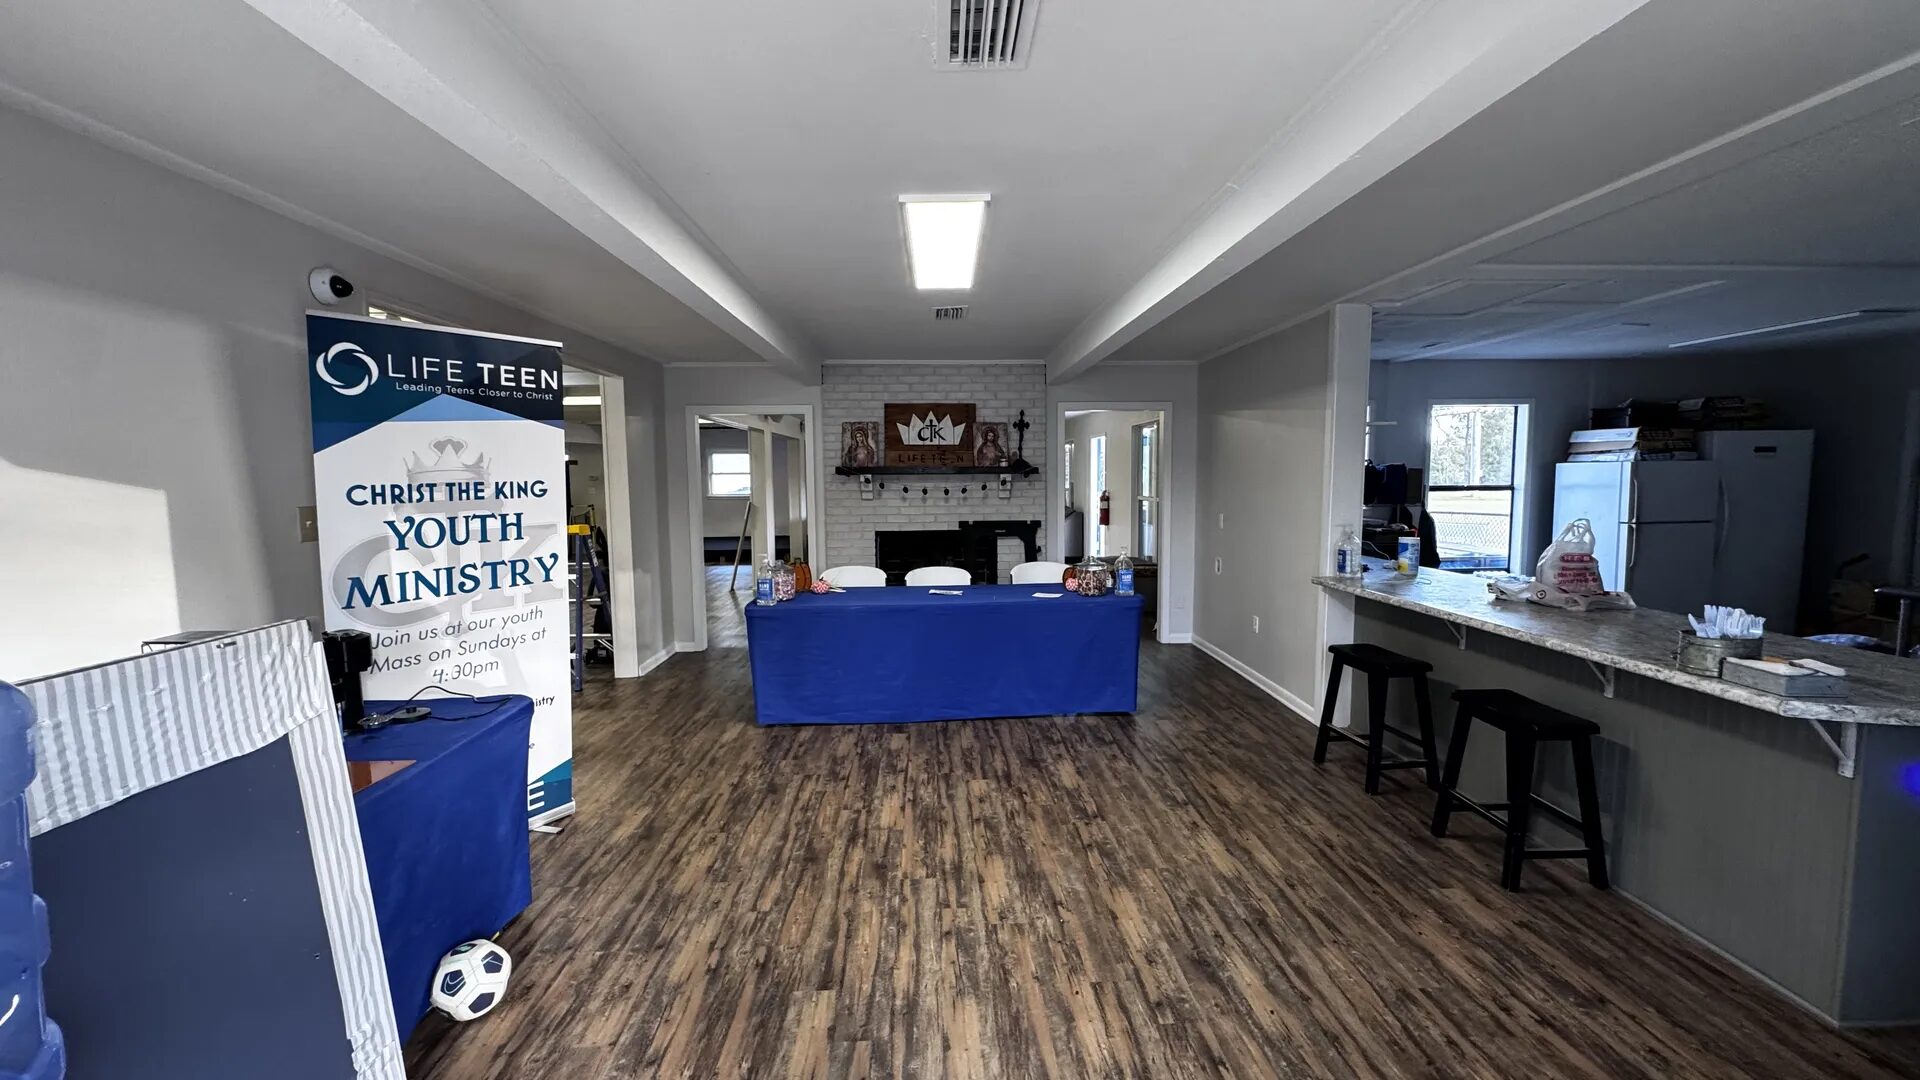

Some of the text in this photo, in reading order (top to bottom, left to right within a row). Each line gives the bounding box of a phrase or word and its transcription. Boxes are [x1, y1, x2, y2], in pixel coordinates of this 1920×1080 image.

[387, 353, 558, 390] LIFE TEEN
[395, 382, 553, 400] Leading Teens Closer to Christ
[345, 480, 548, 506] CHRIST THE KING
[383, 511, 525, 551] YOUTH
[341, 552, 560, 610] MINISTRY
[371, 605, 543, 650] Join us at our youth
[369, 627, 547, 675] Mass on Sundays at
[432, 660, 499, 684] 4:30pm
